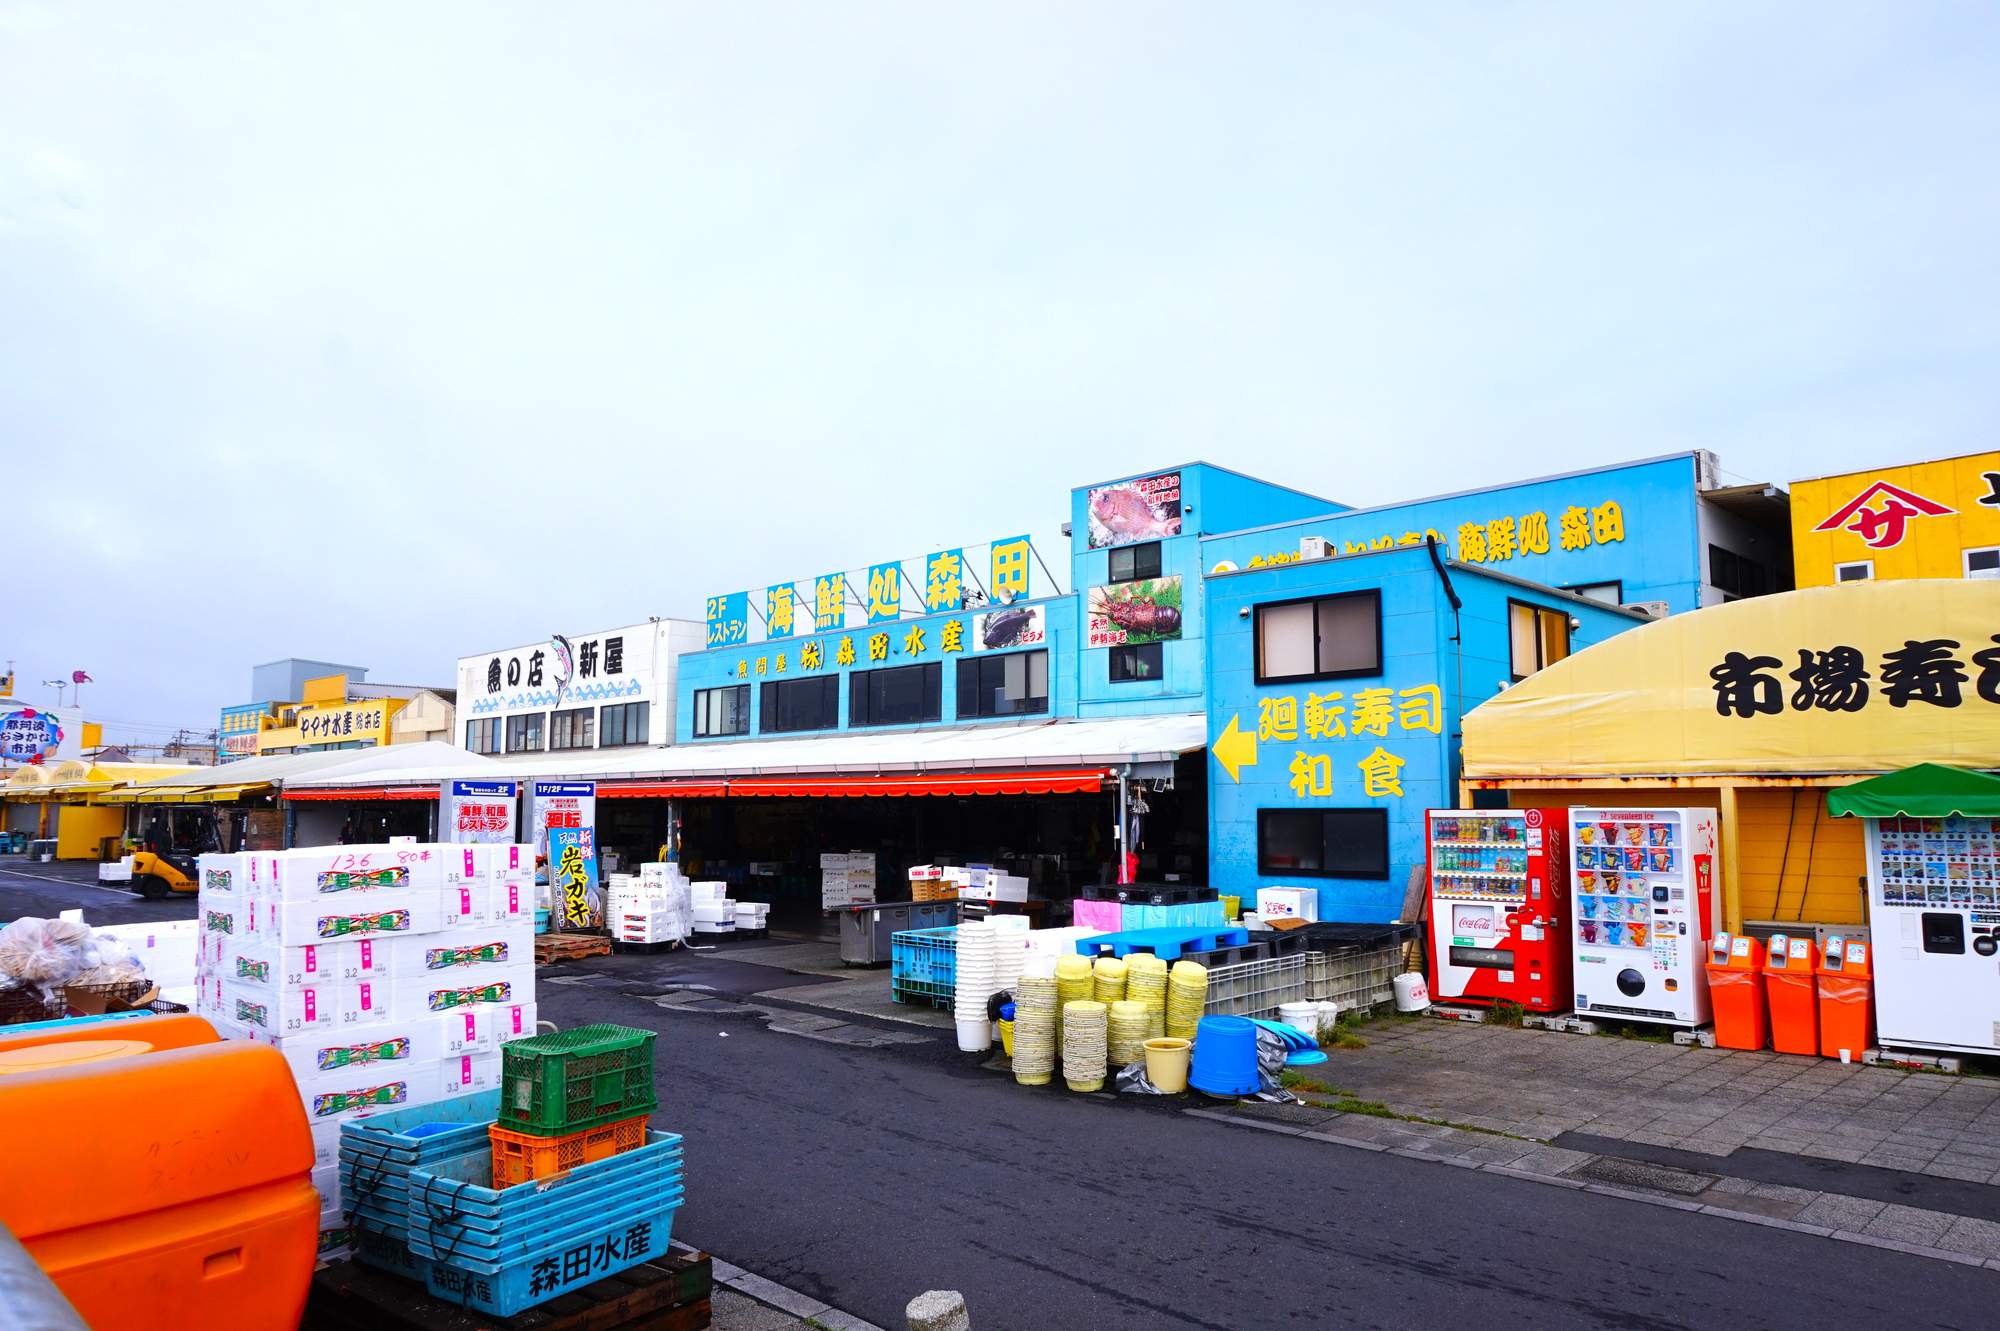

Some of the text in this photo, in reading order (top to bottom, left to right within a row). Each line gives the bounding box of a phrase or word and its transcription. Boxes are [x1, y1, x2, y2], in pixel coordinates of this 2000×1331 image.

[1140, 476, 1180, 492] 森田水産の
[1458, 511, 1550, 563] 海鮮処
[1559, 500, 1625, 551] 森田
[767, 539, 1030, 636] 海鮮処森田
[707, 597, 727, 620] 2F
[707, 619, 747, 645] レストラン
[1091, 618, 1108, 630] 天然
[1022, 630, 1044, 642] ヒラメ
[1091, 631, 1127, 645] 伊勢海老
[487, 637, 624, 694] 魚の店 新屋
[737, 653, 787, 679] 魚問屋
[1258, 684, 1443, 742] 廻転寿司
[5, 719, 46, 731] 那珂湊
[0, 731, 51, 742] おさかな
[11, 743, 37, 754] 市場
[1289, 746, 1406, 798] 和食
[538, 785, 562, 793] 1F/2F
[460, 805, 507, 817] 海鮮 和風
[1610, 811, 1643, 820] seventeen
[1644, 811, 1655, 820] ice
[459, 818, 508, 831] レストラン
[546, 811, 581, 828] 廻転
[559, 833, 578, 845] 天然
[578, 829, 595, 861] 新鮮
[330, 854, 372, 870] 136
[560, 845, 590, 927] 岩ガキ
[529, 1222, 652, 1298] 森田水産
[431, 1266, 493, 1304] 森田水産
